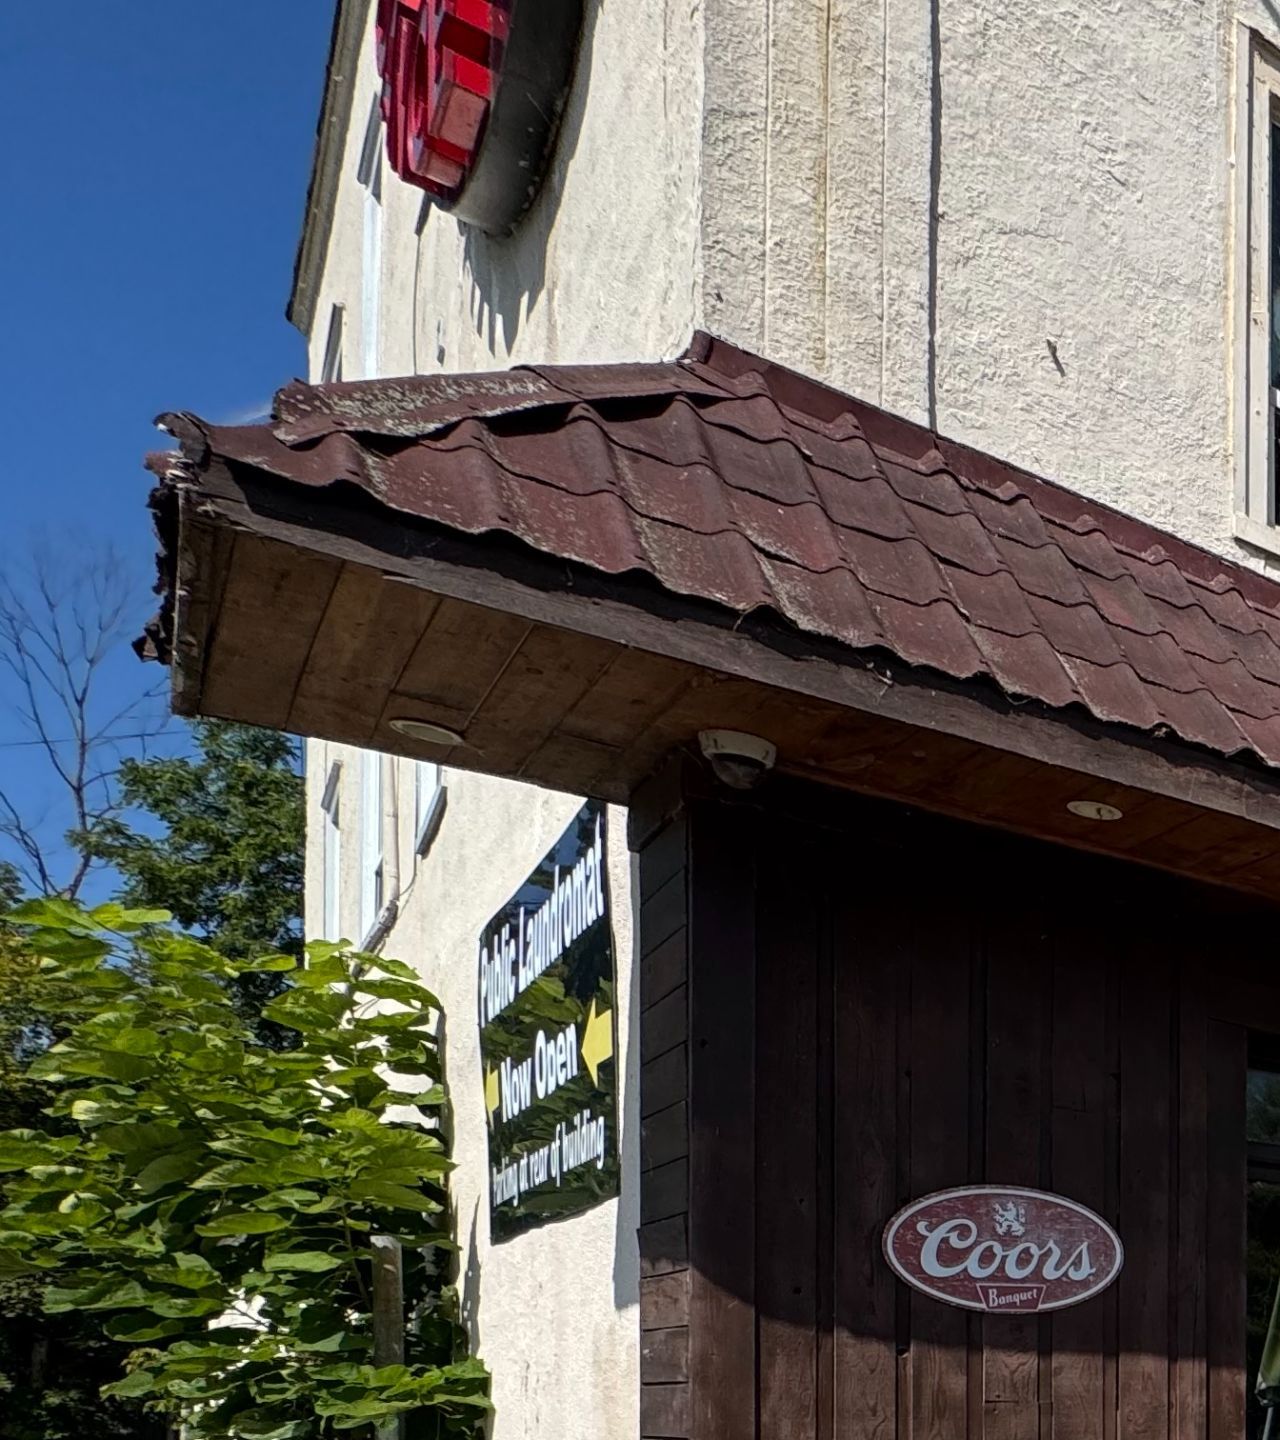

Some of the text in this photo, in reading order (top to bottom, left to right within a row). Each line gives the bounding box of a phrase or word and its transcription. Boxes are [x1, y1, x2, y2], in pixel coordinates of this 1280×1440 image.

[481, 811, 604, 1029] Public Laundromat
[500, 1023, 578, 1123] Now Open
[519, 1152, 528, 1192] at
[529, 1145, 549, 1188] rear
[550, 1123, 560, 1187] of
[562, 1109, 605, 1169] building
[916, 1218, 1096, 1281] Coors
[989, 1288, 1038, 1307] Banquet
